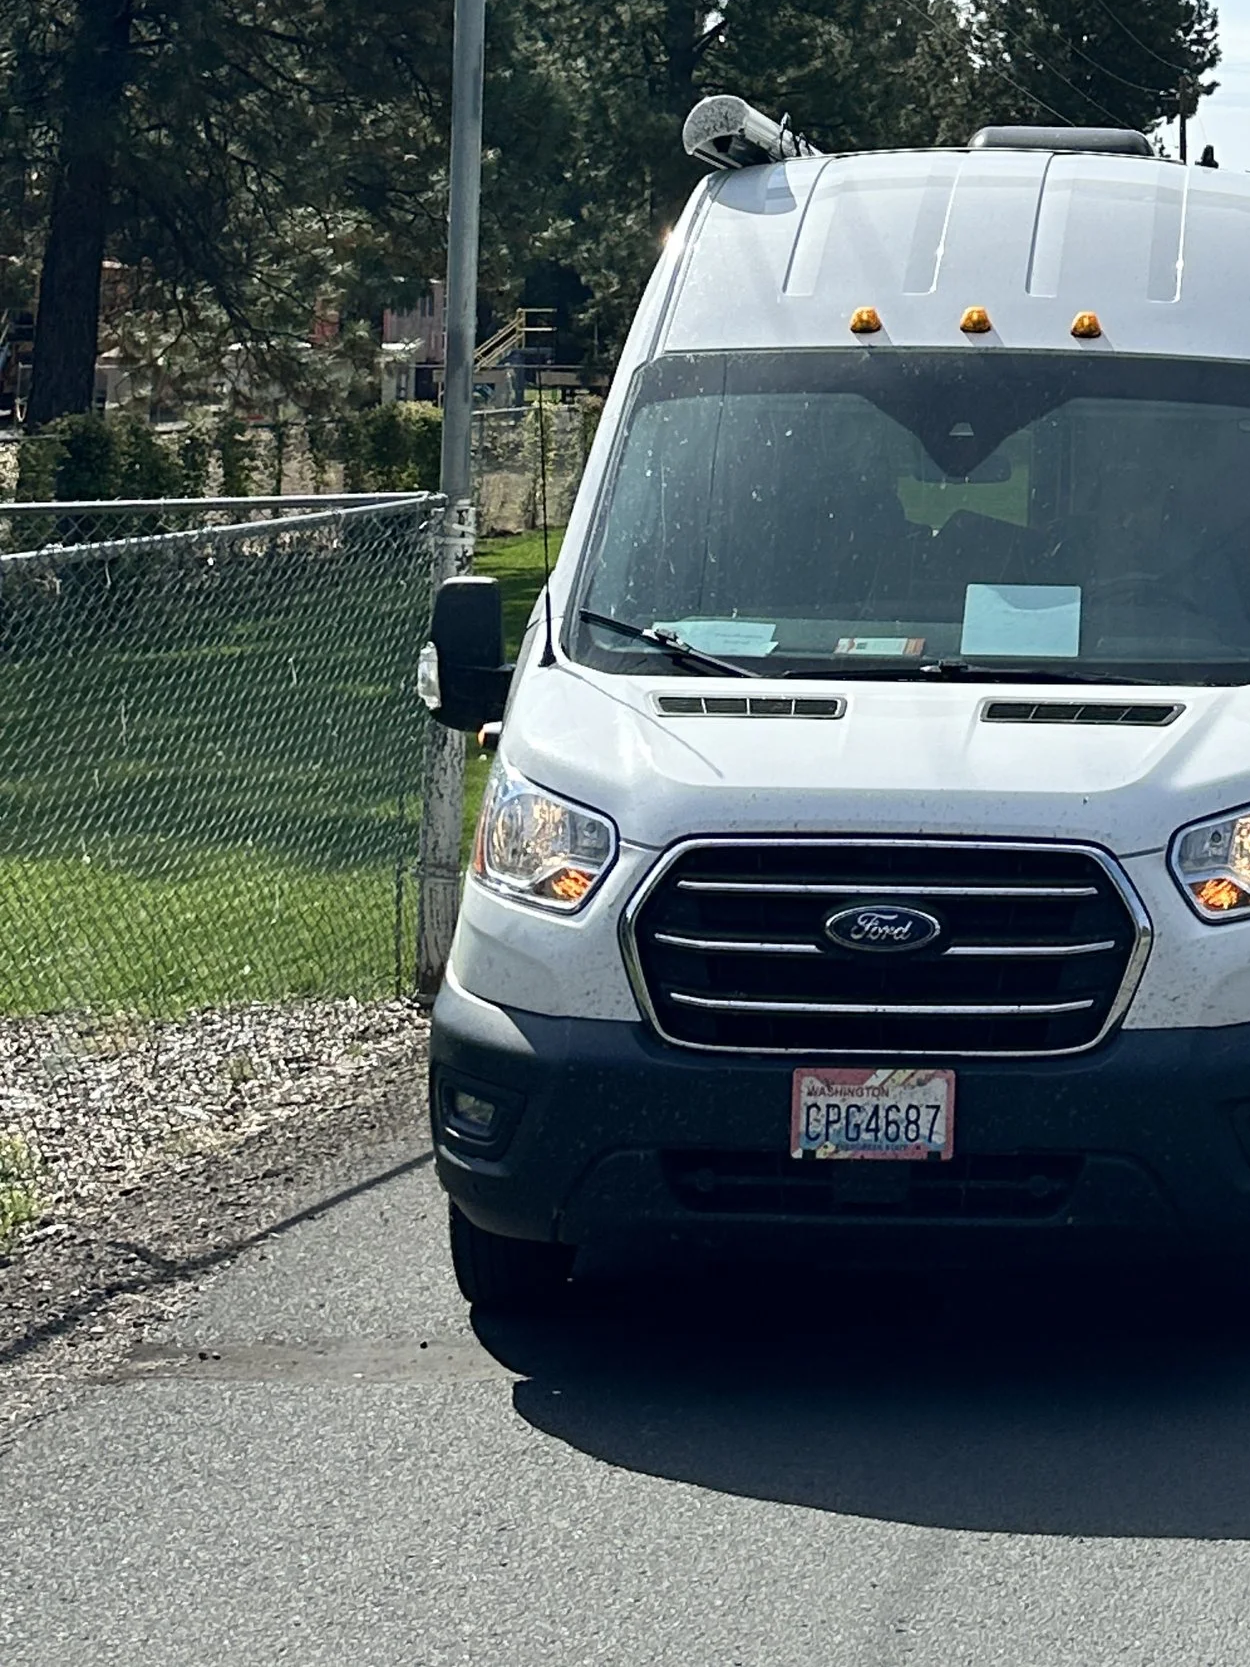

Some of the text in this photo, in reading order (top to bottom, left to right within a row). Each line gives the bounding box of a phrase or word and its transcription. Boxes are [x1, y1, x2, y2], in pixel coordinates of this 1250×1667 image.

[850, 912, 914, 941] Ford
[806, 1086, 890, 1099] WASHINGTON
[805, 1103, 942, 1143] CPG4687
